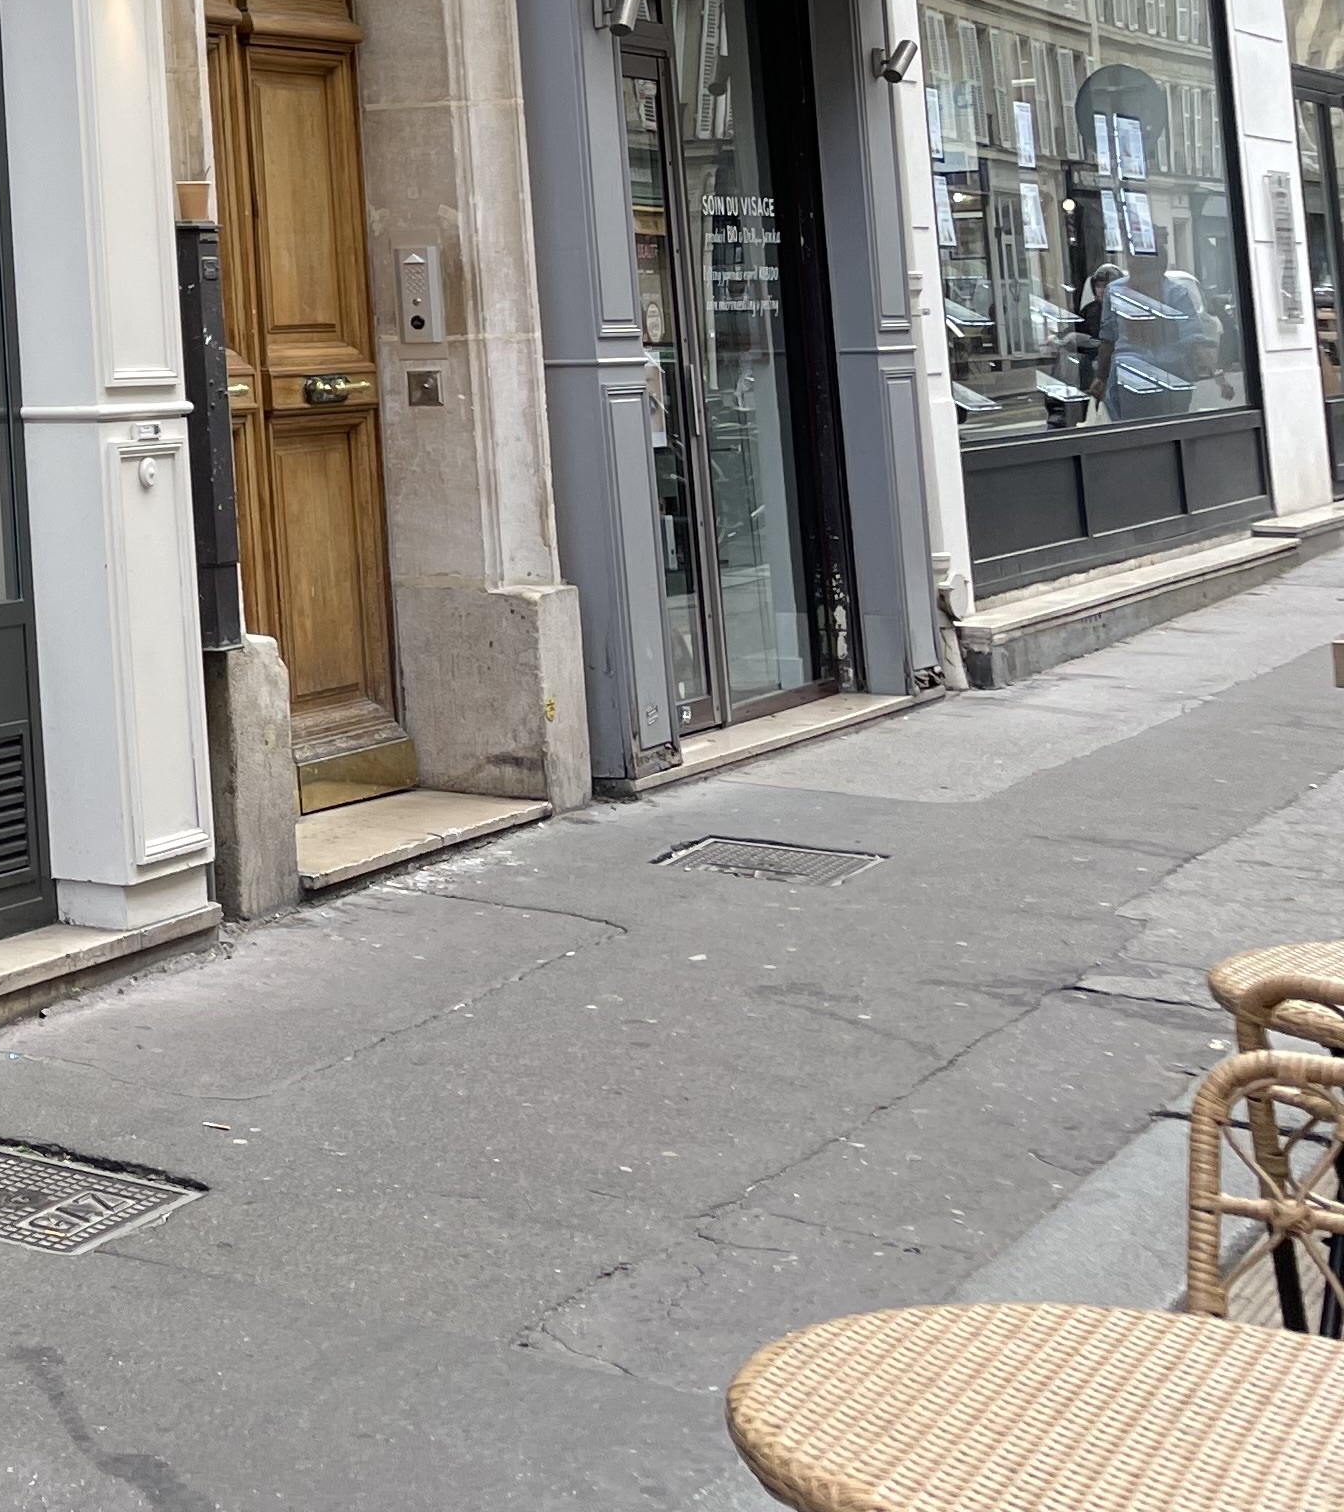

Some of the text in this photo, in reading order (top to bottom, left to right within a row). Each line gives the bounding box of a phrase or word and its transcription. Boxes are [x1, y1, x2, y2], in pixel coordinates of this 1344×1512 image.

[702, 195, 775, 217] SOIN DU VISAGE
